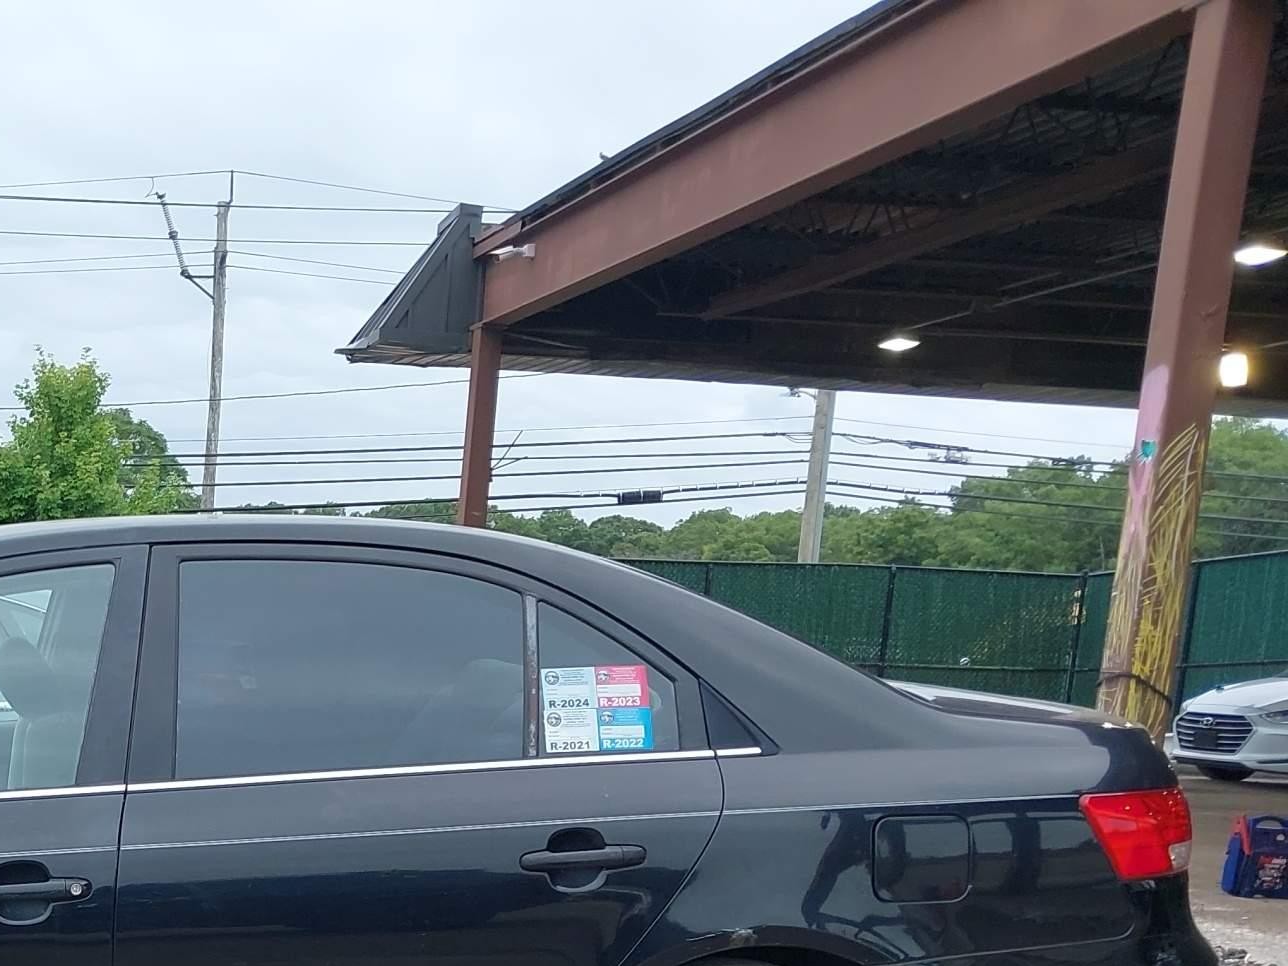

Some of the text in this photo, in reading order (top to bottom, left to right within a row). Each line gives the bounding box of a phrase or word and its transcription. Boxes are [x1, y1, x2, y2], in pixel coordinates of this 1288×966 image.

[548, 698, 590, 708] R-2024
[599, 697, 641, 707] R-2023
[550, 741, 591, 751] R-2021
[603, 739, 644, 749] R-2022
